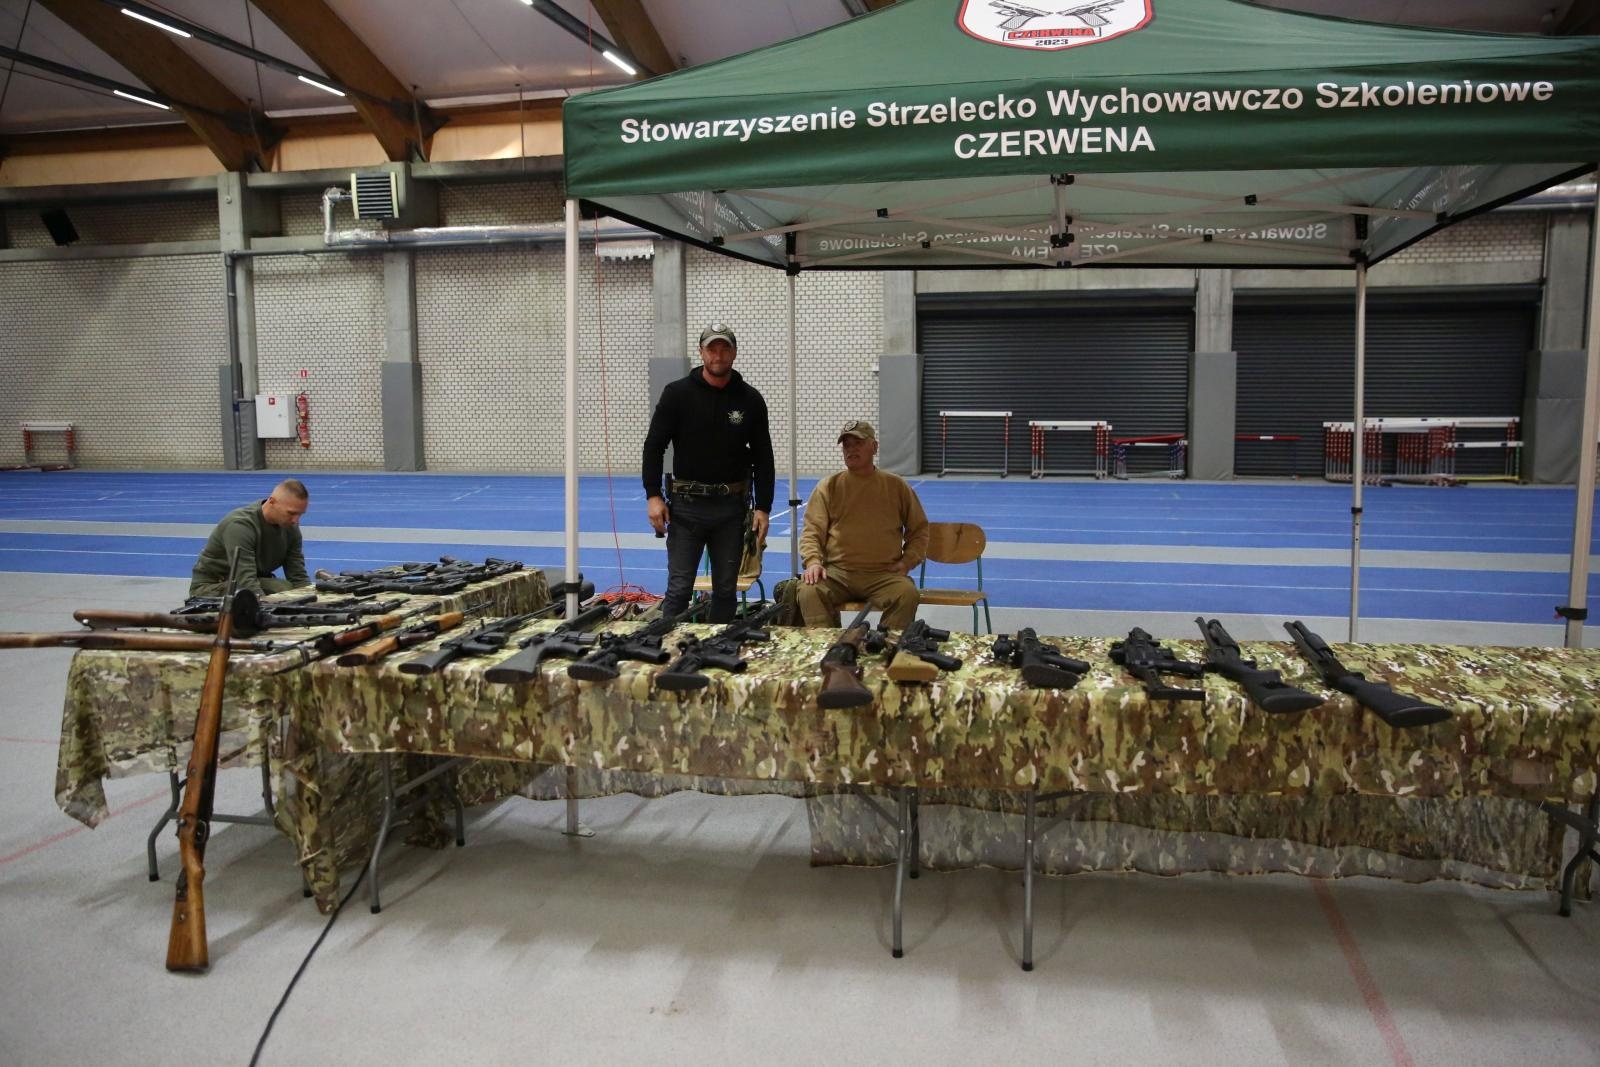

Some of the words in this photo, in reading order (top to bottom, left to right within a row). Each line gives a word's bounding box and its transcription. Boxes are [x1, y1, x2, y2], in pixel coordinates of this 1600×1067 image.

[1008, 28, 1096, 39] CZERWENA
[620, 106, 856, 143] Stowarzyszenie
[866, 94, 1037, 127] Strzelecko
[1047, 87, 1303, 122] Wychowawczo
[1315, 80, 1554, 108] Szkoleniowe
[954, 126, 1156, 159] CZERWENA
